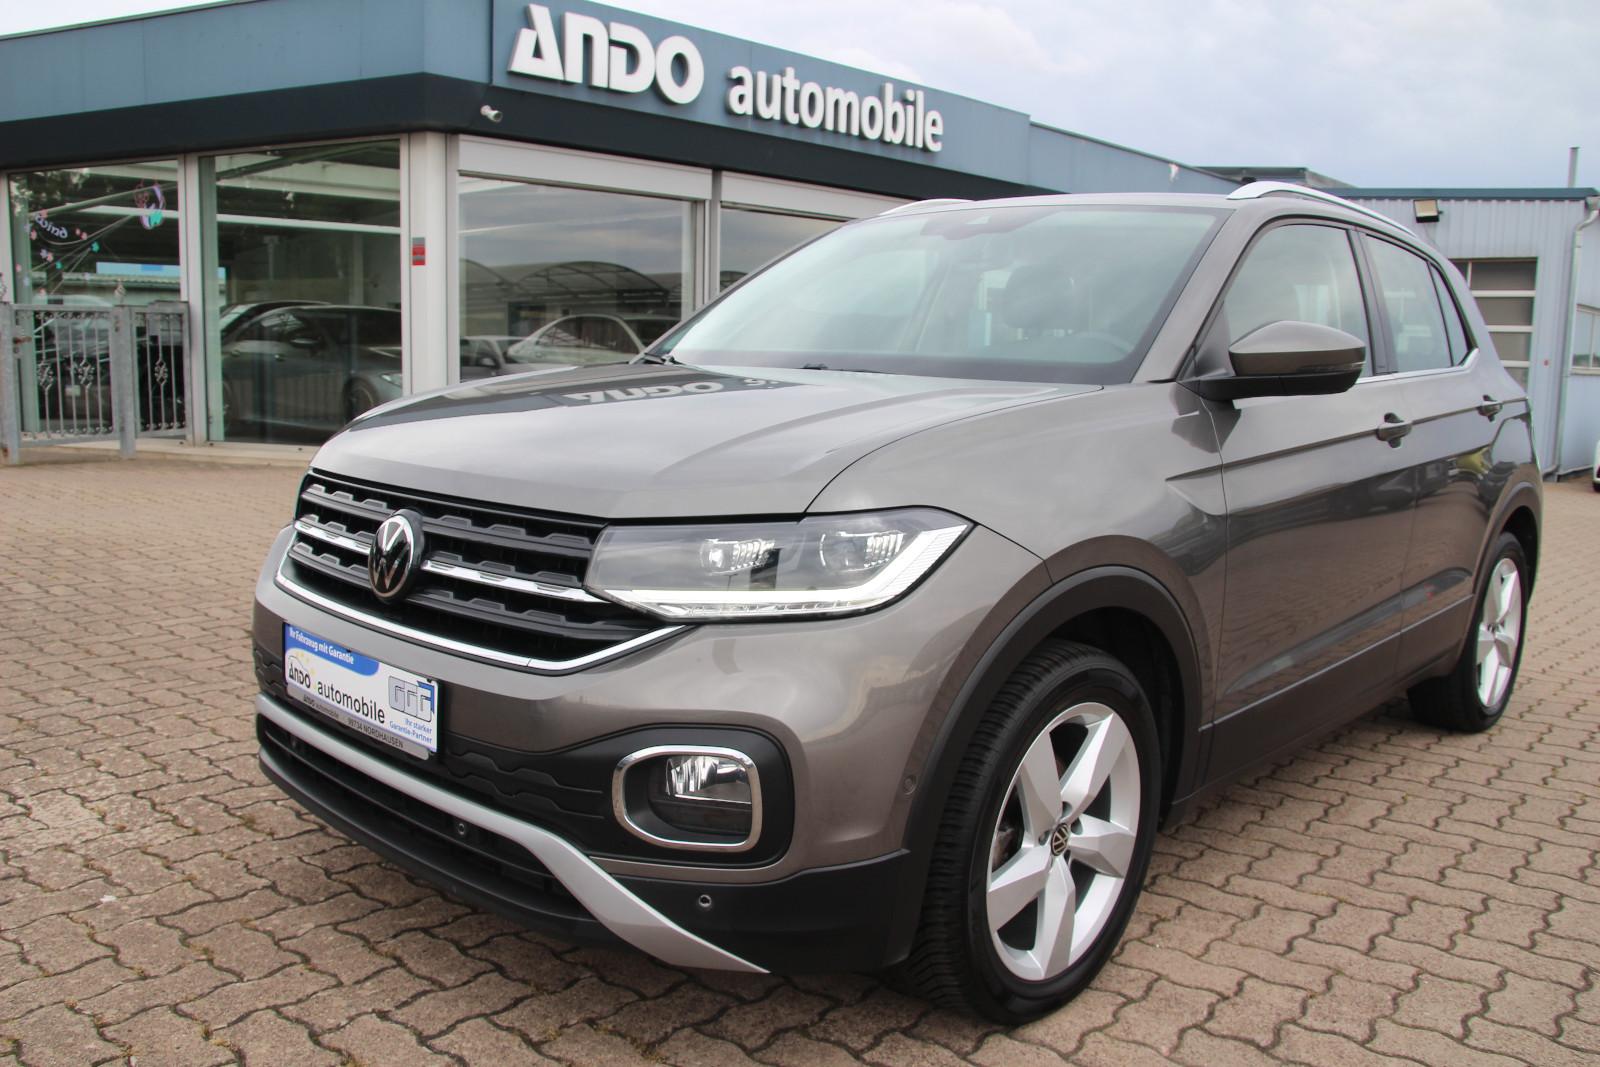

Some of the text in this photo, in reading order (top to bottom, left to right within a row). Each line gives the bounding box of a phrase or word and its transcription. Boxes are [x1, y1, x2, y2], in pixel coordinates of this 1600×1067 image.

[507, 3, 944, 153] ANDO automobile
[296, 631, 318, 652] Fahrzeug
[318, 642, 328, 654] mit
[328, 645, 354, 665] Garantie
[317, 681, 385, 724] automobile
[389, 720, 432, 744] Garantie-Partner
[404, 717, 412, 726] Ihr
[363, 724, 404, 749] NORDHAUSEN
